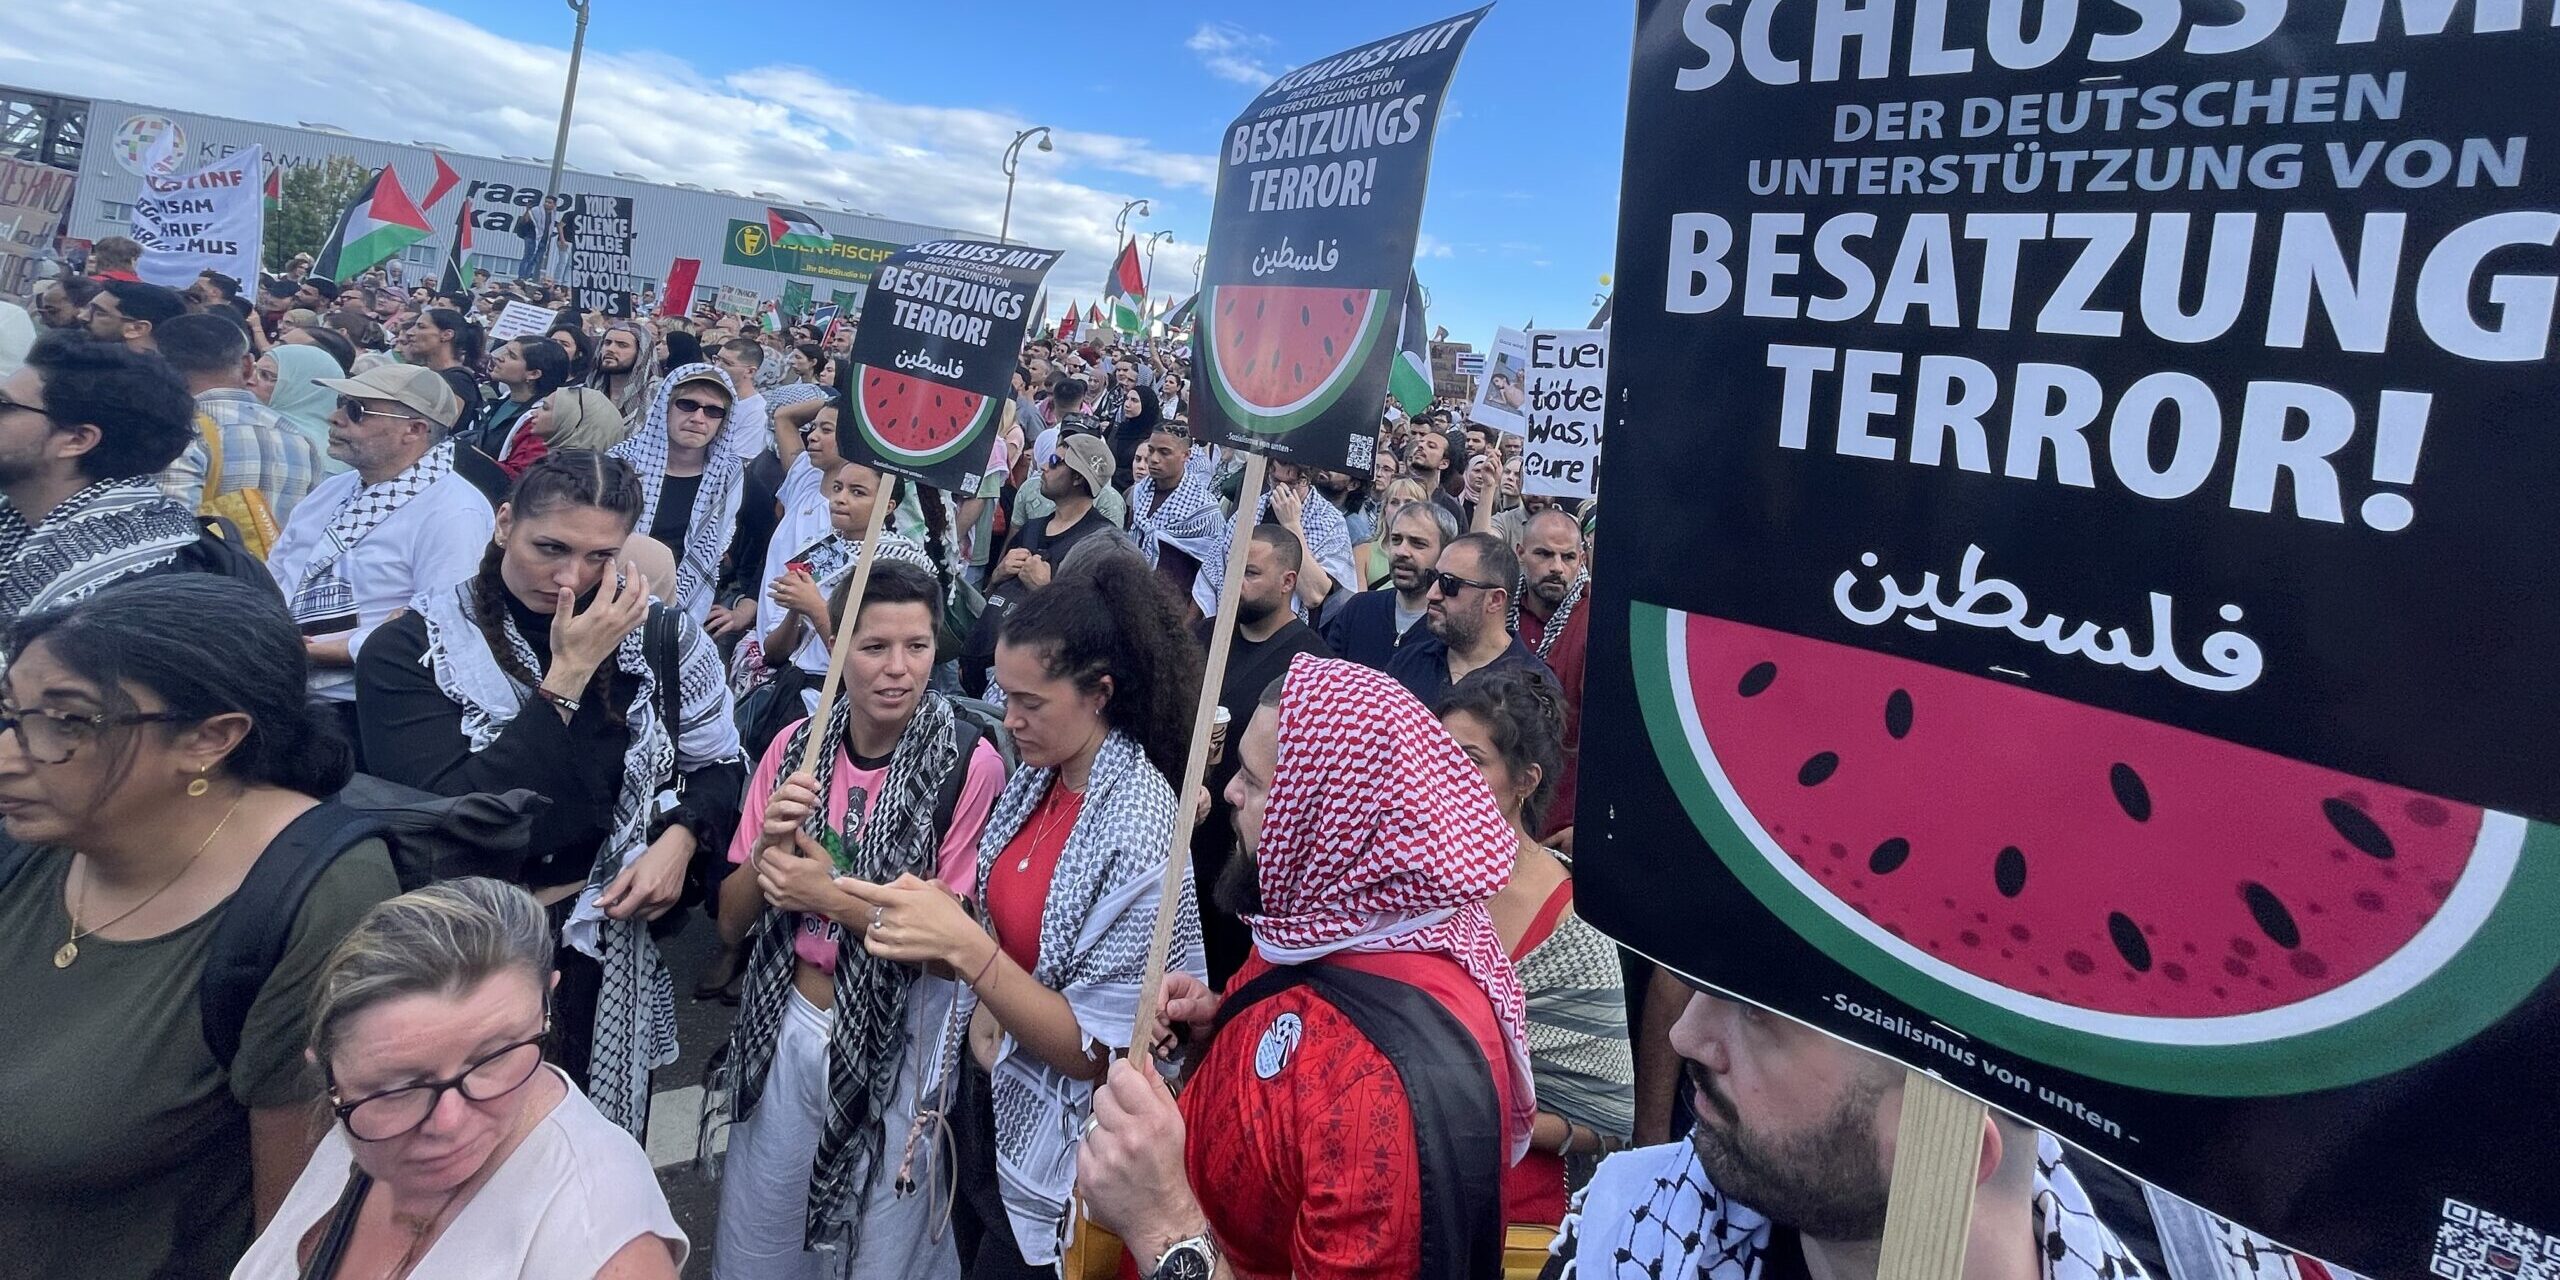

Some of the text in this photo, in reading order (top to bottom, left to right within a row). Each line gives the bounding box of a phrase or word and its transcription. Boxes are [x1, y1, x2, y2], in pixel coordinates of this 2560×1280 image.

[1265, 17, 1474, 97] SCHLUSS MIT
[1259, 79, 1405, 118] UNTERSTÜTZUNG VON
[1286, 66, 1395, 100] DER DEUTSCHEN
[1834, 72, 2407, 142] DER DEUTSCHEN
[1230, 94, 1426, 165] BESATZUNGS
[1249, 157, 1377, 212] TERROR!
[1748, 137, 2526, 195] UNTERSTÜTZUNG VON
[574, 214, 628, 238] SILENCE
[584, 196, 617, 218] YOUR
[572, 252, 631, 275] STUDIED
[905, 260, 1011, 288] UNTERSTÜTZUNG VON
[906, 242, 1052, 270] SCHLUSS MIT
[947, 258, 1003, 274] DEUTSCHEN
[1252, 236, 1339, 277] فلسطين
[580, 289, 619, 315] KIDS
[878, 266, 1025, 320] BESATZUNGS
[1666, 211, 2560, 362] BESATZUNG
[892, 299, 992, 346] TERROR!
[895, 348, 963, 378] فلسطين
[1767, 344, 2433, 531] TERROR!
[1833, 543, 2264, 693] فلسطين
[1981, 1059, 2031, 1093] von
[2038, 1086, 2122, 1139] unten
